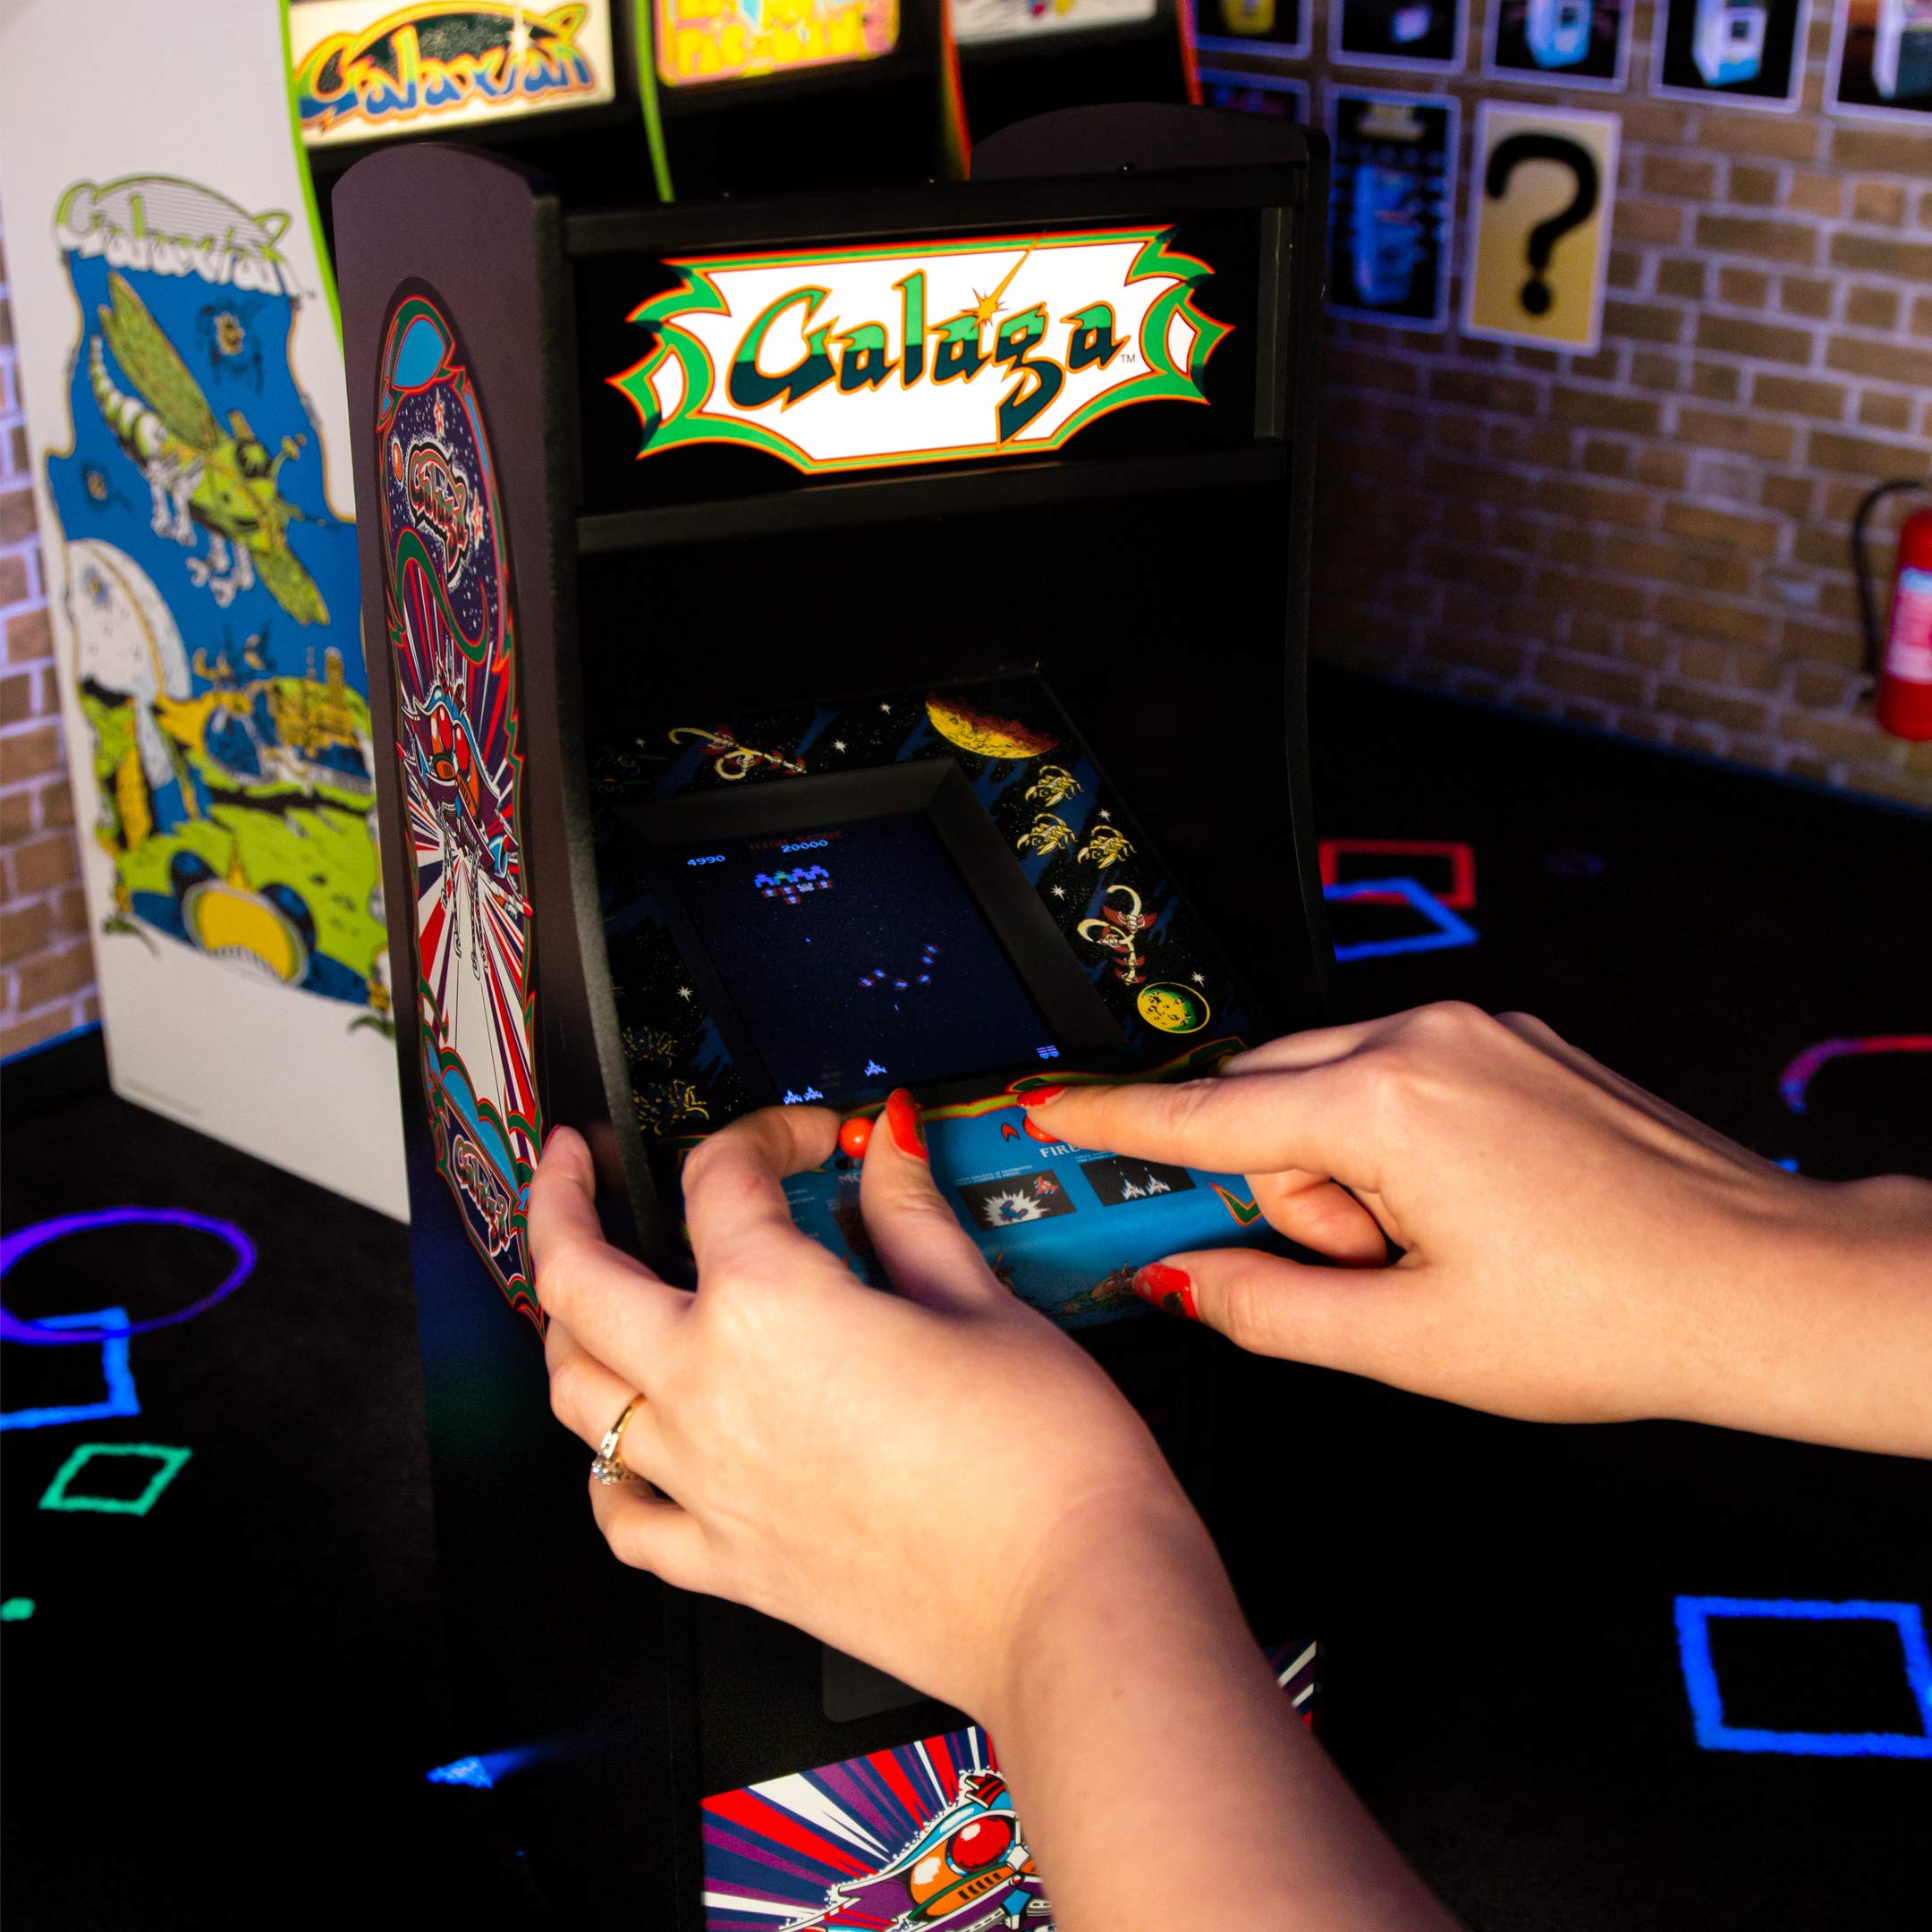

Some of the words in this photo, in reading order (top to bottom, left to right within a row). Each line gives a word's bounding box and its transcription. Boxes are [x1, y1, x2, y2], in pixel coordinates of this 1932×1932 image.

[725, 268, 1130, 451] Galaga
[781, 839, 828, 853] 20000
[687, 854, 725, 867] 4990
